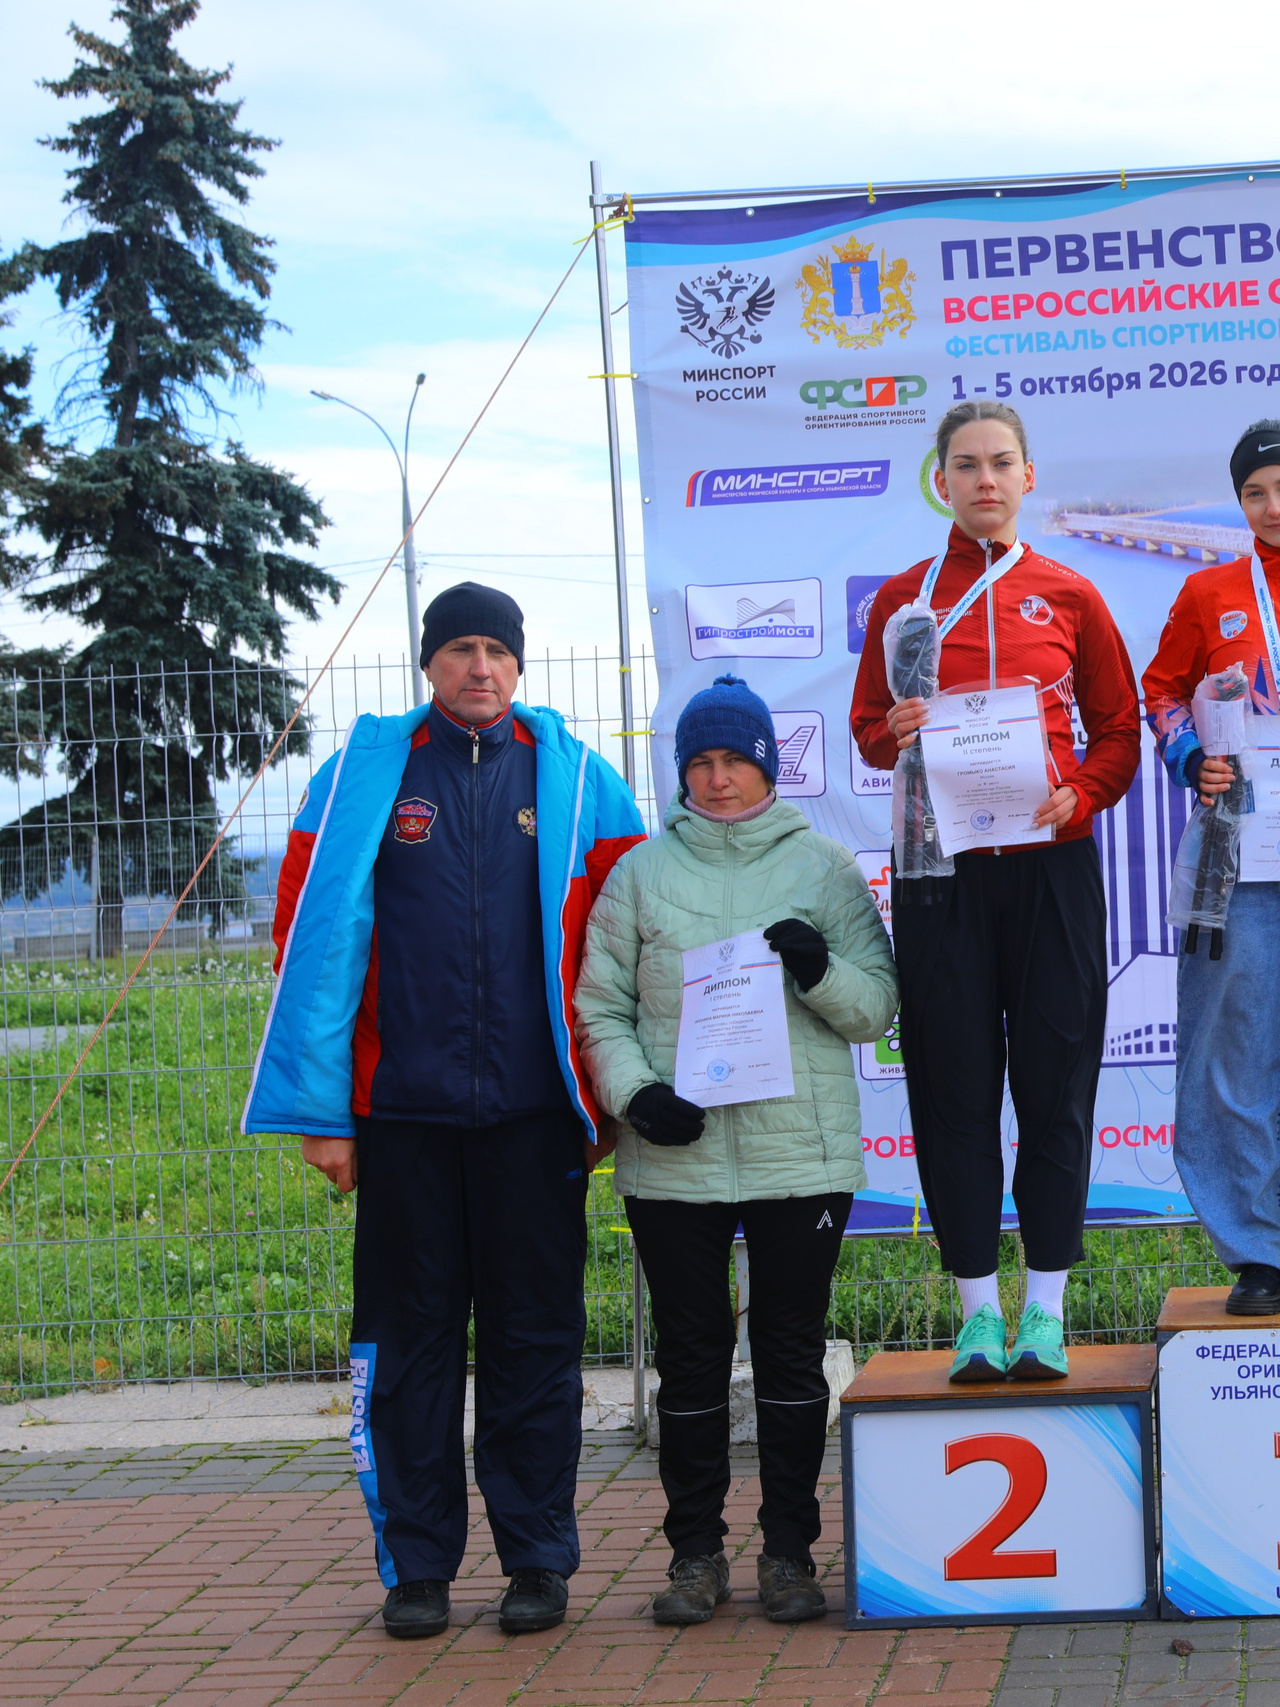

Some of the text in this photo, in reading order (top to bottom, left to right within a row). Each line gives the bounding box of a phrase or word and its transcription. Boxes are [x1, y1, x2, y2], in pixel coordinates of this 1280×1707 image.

[943, 278, 1260, 324] ВСЕРОССИЙСКИЕ
[945, 328, 1106, 359] ФЕСТИВАЛЬ
[682, 365, 776, 383] МИНСПОРТ
[952, 374, 967, 400] 1
[996, 372, 1012, 398] 5
[1020, 366, 1141, 399] октября
[1148, 360, 1228, 389] 2026
[696, 386, 767, 403] РОССИИ
[804, 410, 926, 423] ФЕДЕРАЦИЯ СПОРТИВНОГО
[805, 418, 926, 430] ОРИЕНТИРОВАНИЯ РОССИИ
[712, 466, 882, 492] МИНСПОРТ
[748, 489, 778, 497] ФИЗИЧЕСКОЙ
[779, 488, 801, 496] КУЛЬТУРЫ
[954, 598, 971, 615] СПОРТА
[970, 579, 987, 598] РОССИИ
[856, 600, 867, 628] РУССКОЕ
[1260, 588, 1271, 624] МИНИСТЕРСТВО
[1267, 625, 1276, 646] СПОРТА
[952, 730, 1010, 748] ДИПЛОМ
[970, 746, 1002, 754] степень
[984, 765, 1016, 773] АНАСТАСИЯ
[703, 976, 751, 996] ДИПЛОМ
[713, 992, 741, 1002] степень
[732, 1009, 764, 1017] НИКОЛАЕВНА
[944, 1432, 1057, 1581] 2
